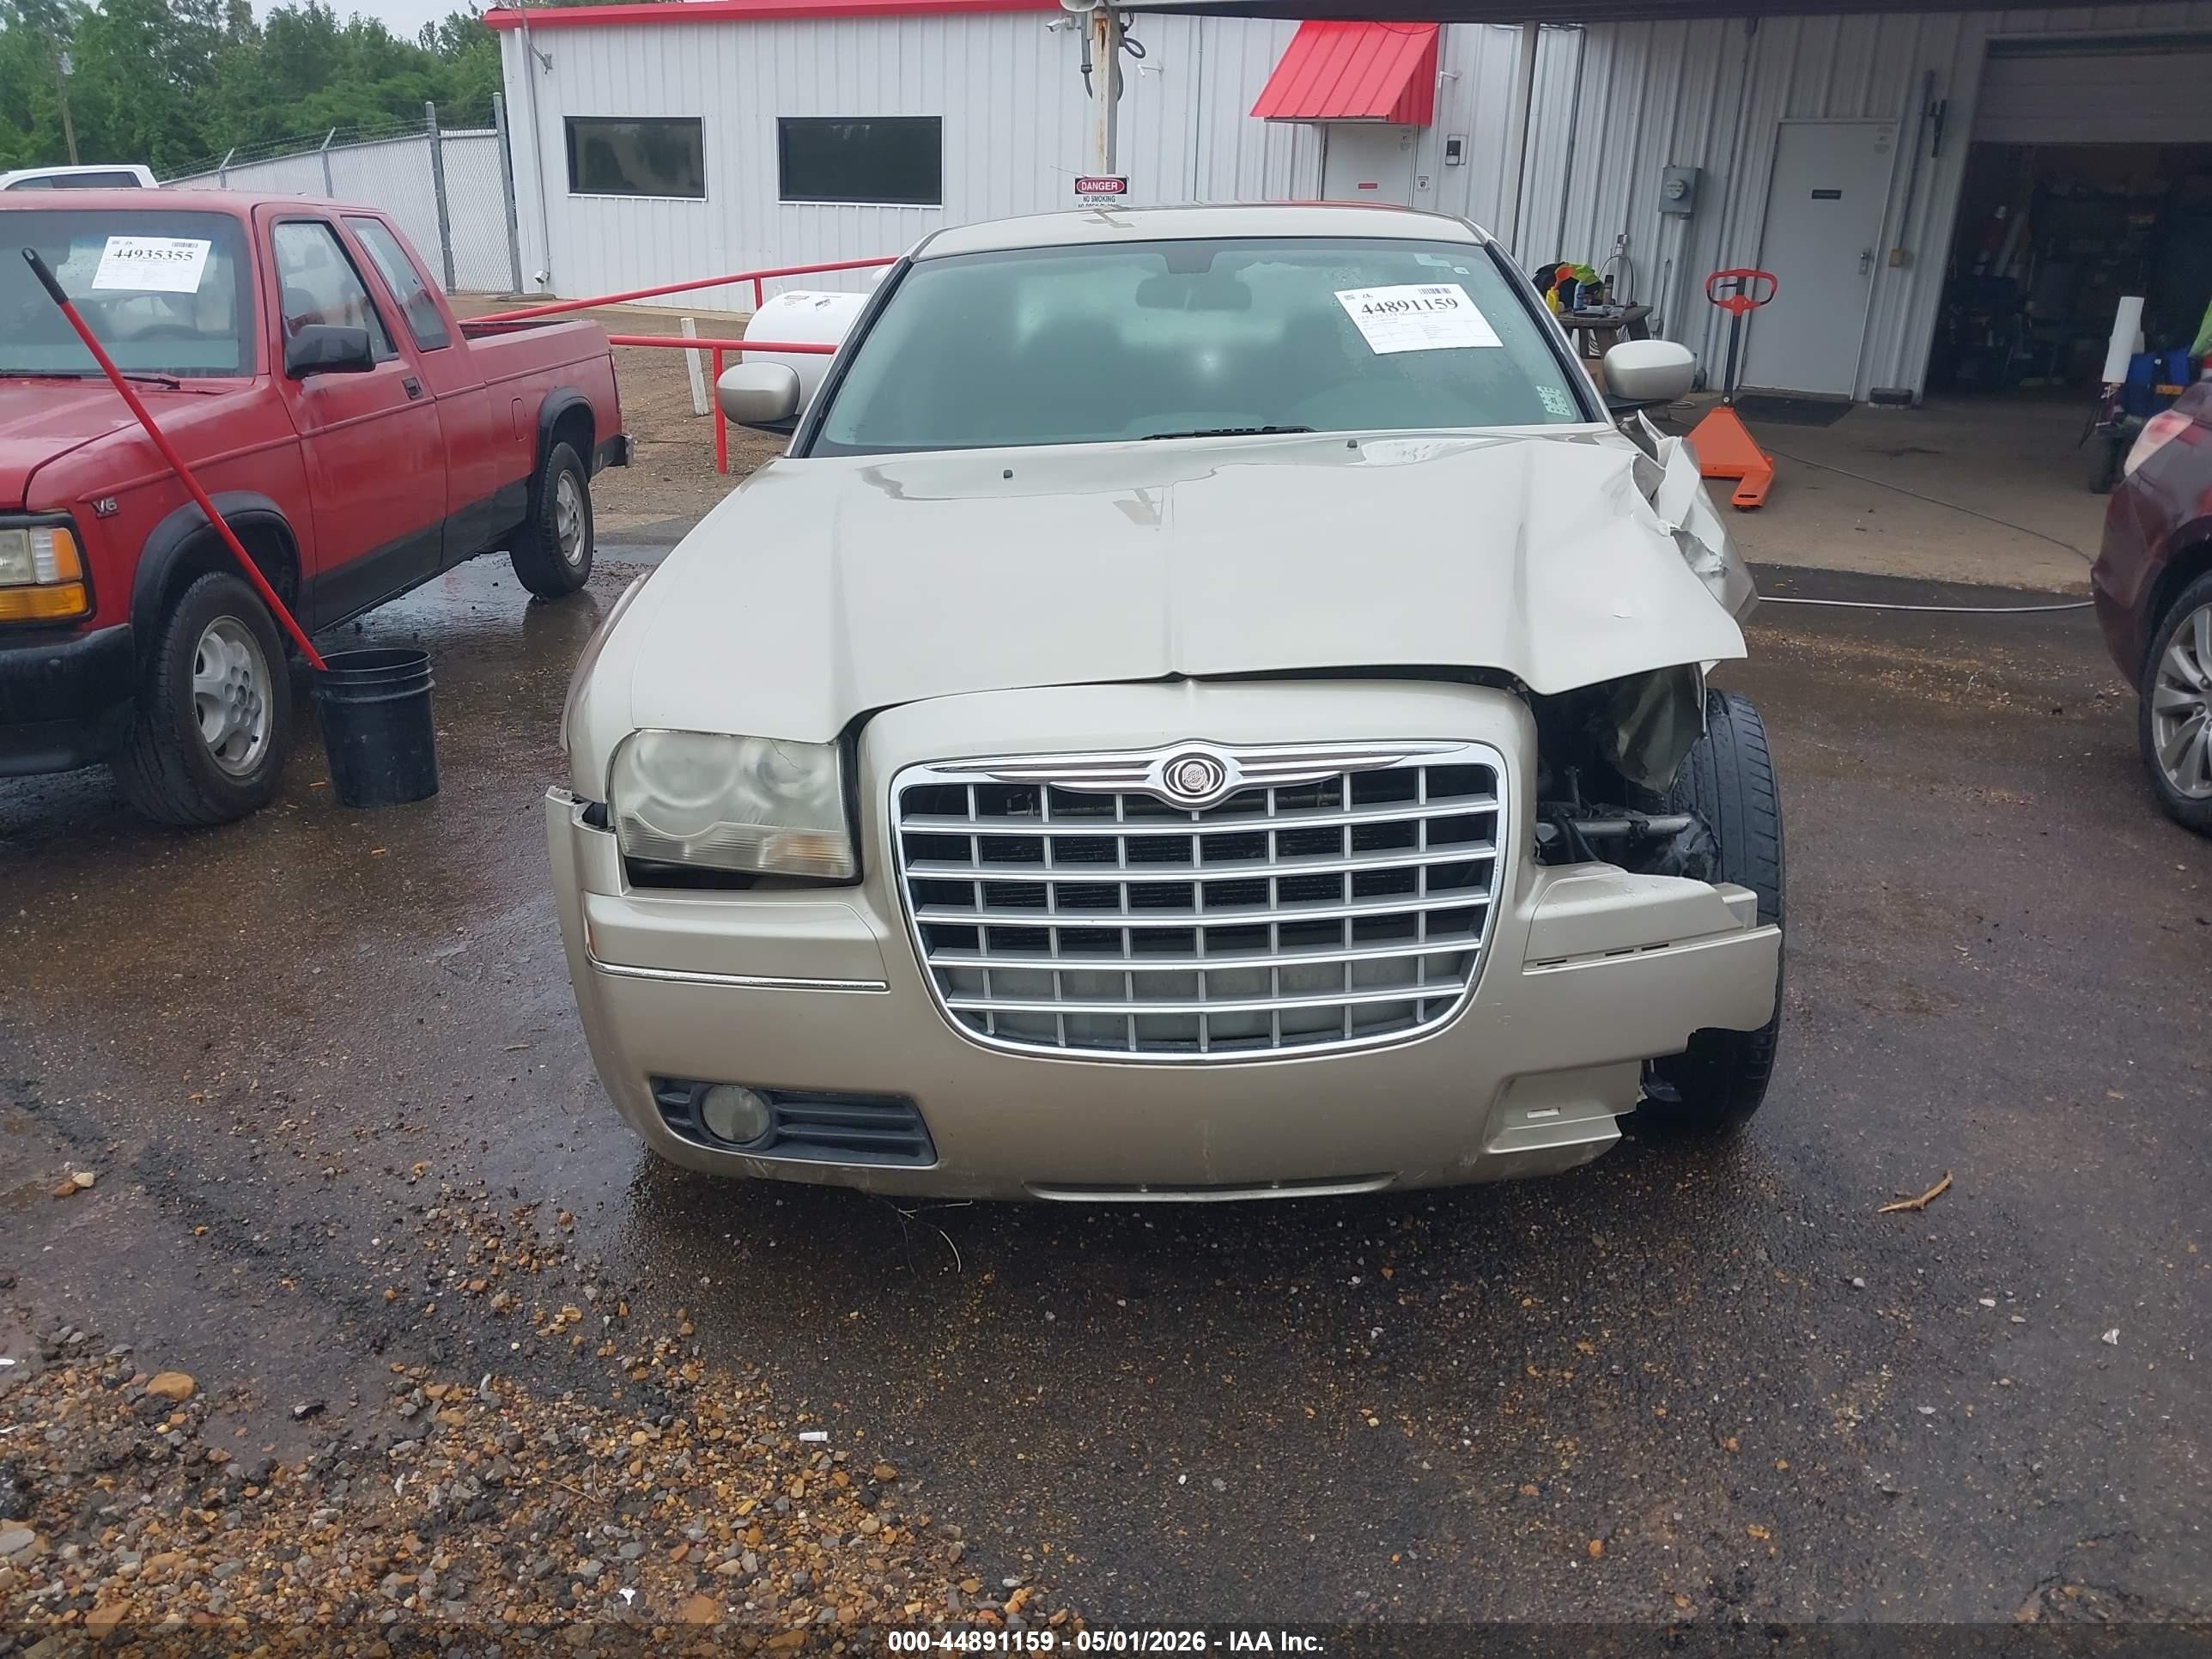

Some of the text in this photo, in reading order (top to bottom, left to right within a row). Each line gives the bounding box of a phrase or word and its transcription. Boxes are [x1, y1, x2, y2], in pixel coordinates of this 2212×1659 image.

[1082, 181, 1118, 191] DANGER
[112, 248, 195, 262] 44935355
[1361, 297, 1459, 315] 44891159
[92, 498, 118, 513] V6
